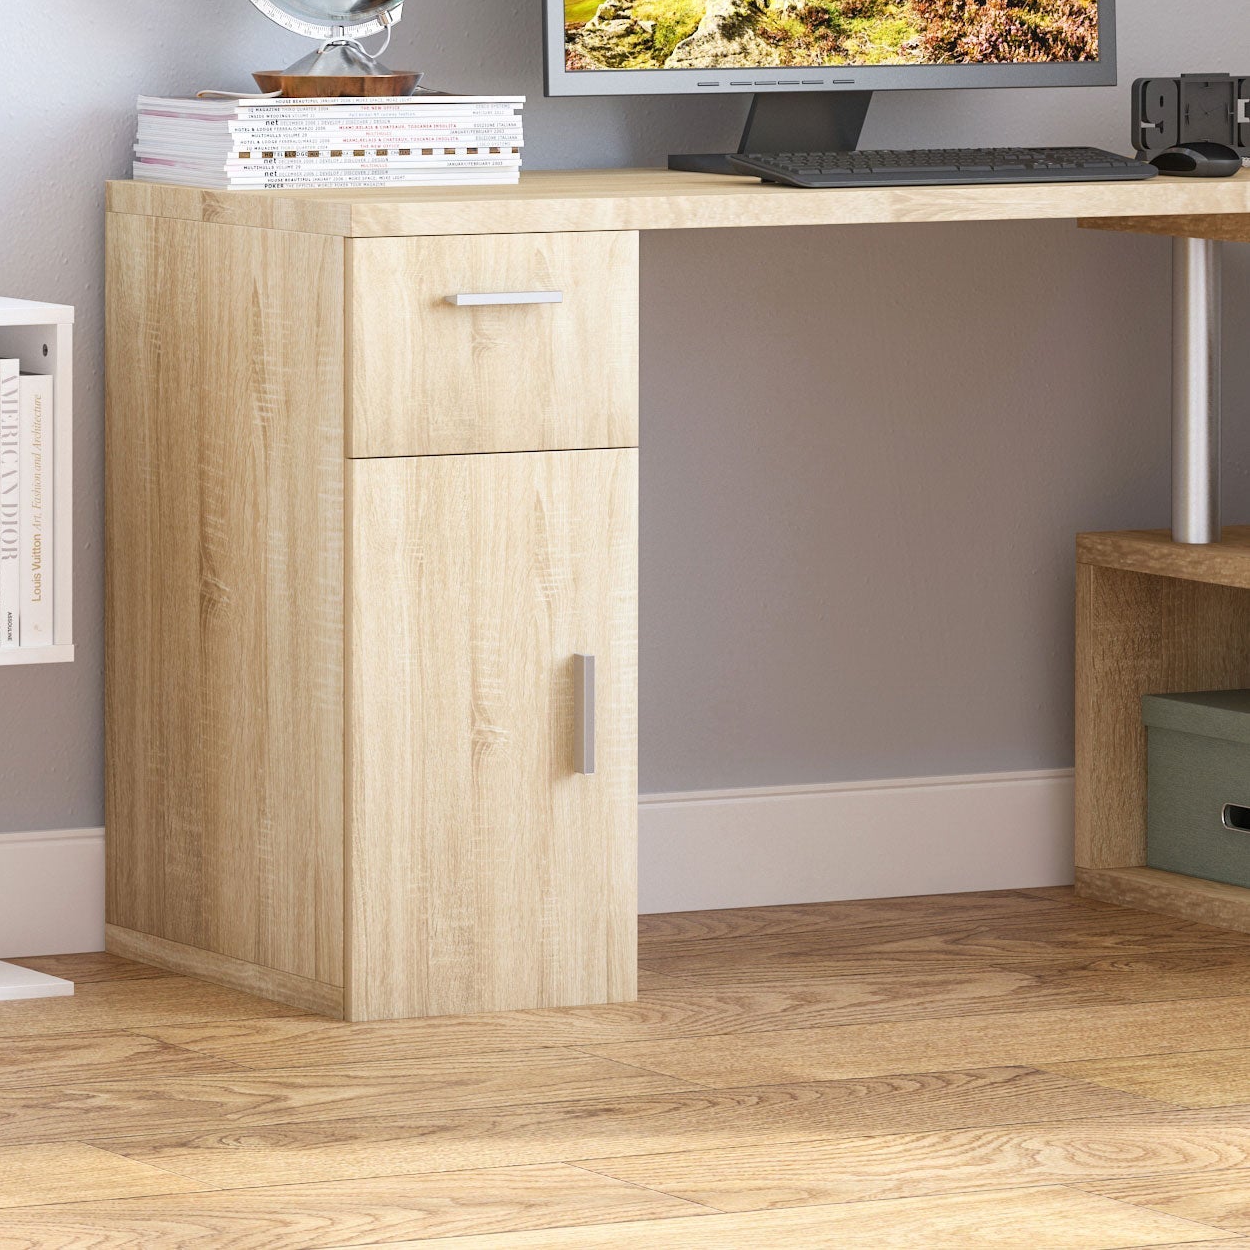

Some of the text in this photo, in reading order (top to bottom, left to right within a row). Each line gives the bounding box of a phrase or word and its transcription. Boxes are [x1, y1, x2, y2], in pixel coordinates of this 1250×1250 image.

[2, 375, 18, 560] AMERICAN DIOR
[32, 534, 41, 602] Louis Vuitton
